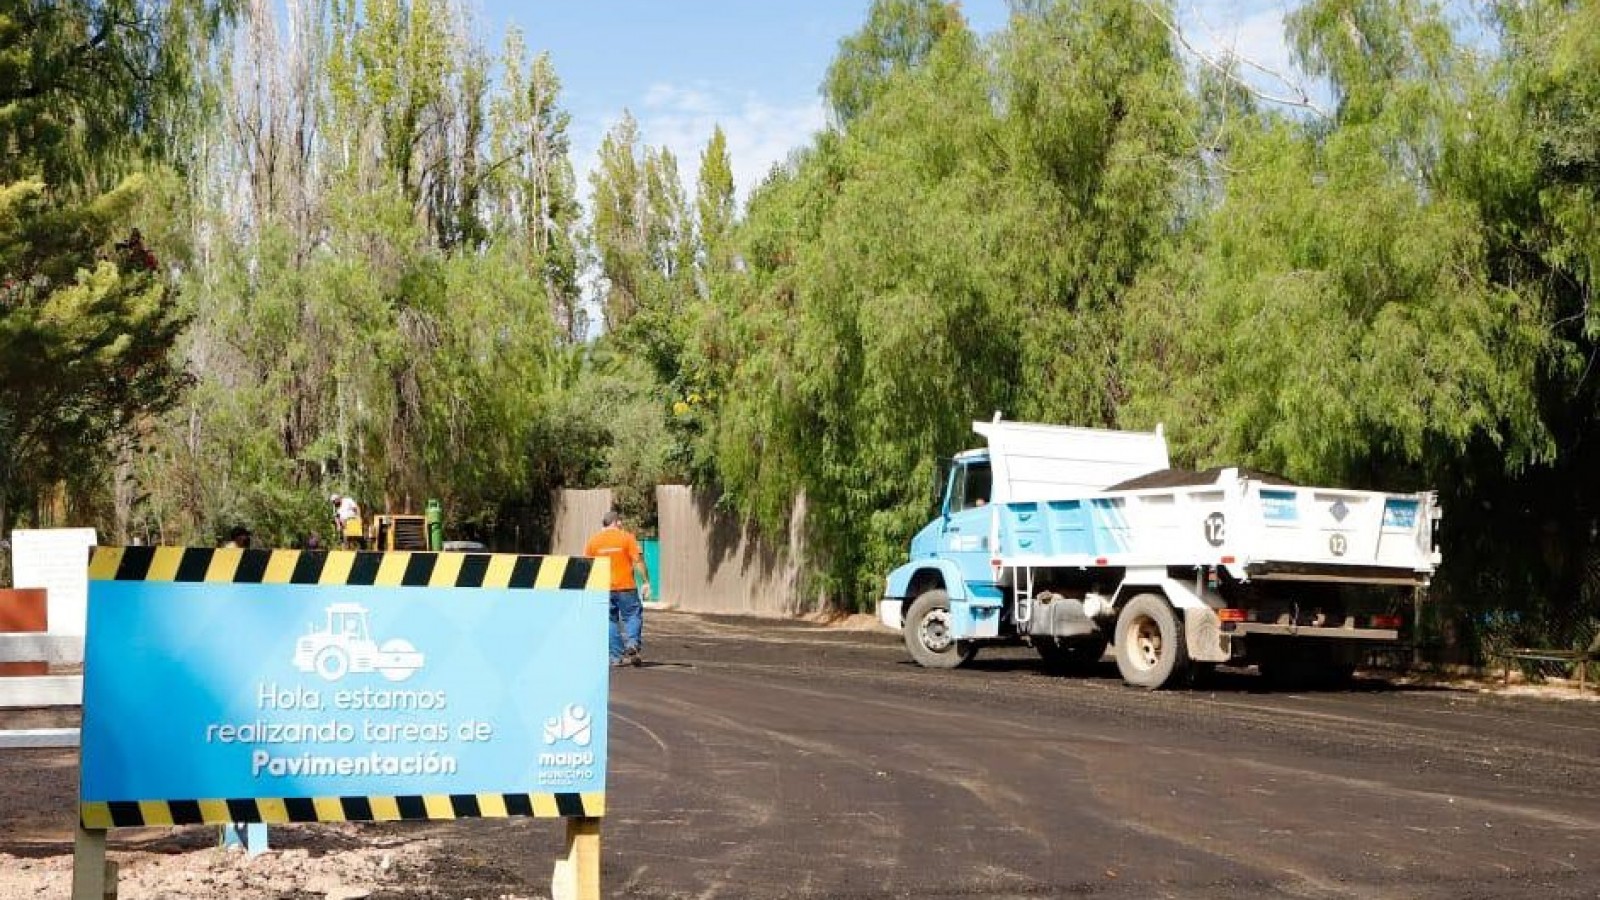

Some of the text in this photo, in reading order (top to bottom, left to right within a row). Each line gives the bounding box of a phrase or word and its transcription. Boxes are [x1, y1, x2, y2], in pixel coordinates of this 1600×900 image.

[1206, 518, 1225, 541] 12
[1332, 538, 1344, 552] 12
[258, 681, 446, 711] Hola, estamos
[206, 719, 493, 742] realizando tareas de
[252, 749, 457, 777] Pavimentación
